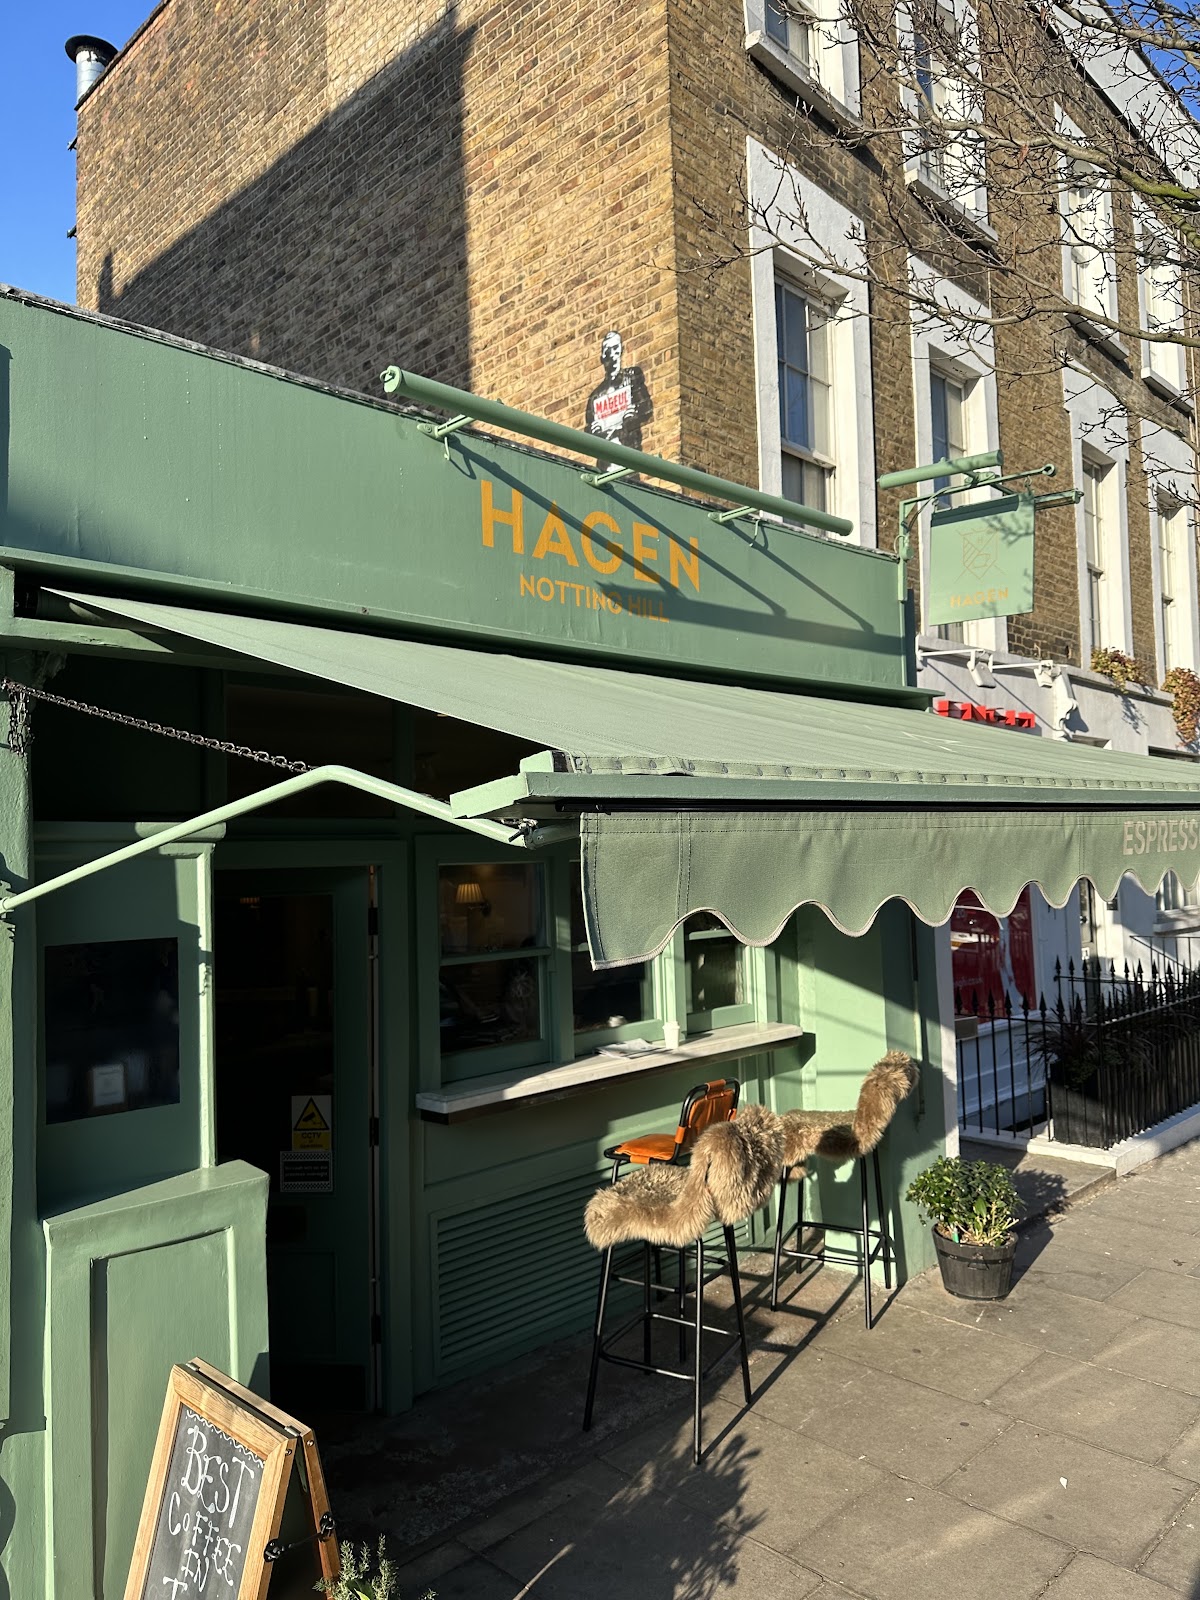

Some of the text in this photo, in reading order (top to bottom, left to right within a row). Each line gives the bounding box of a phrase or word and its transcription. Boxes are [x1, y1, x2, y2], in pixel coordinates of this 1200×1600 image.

[481, 480, 699, 592] HAGEN
[520, 573, 670, 623] NOTTING HILL
[950, 587, 1009, 609] HAGEN
[1123, 819, 1200, 855] ESPRESS
